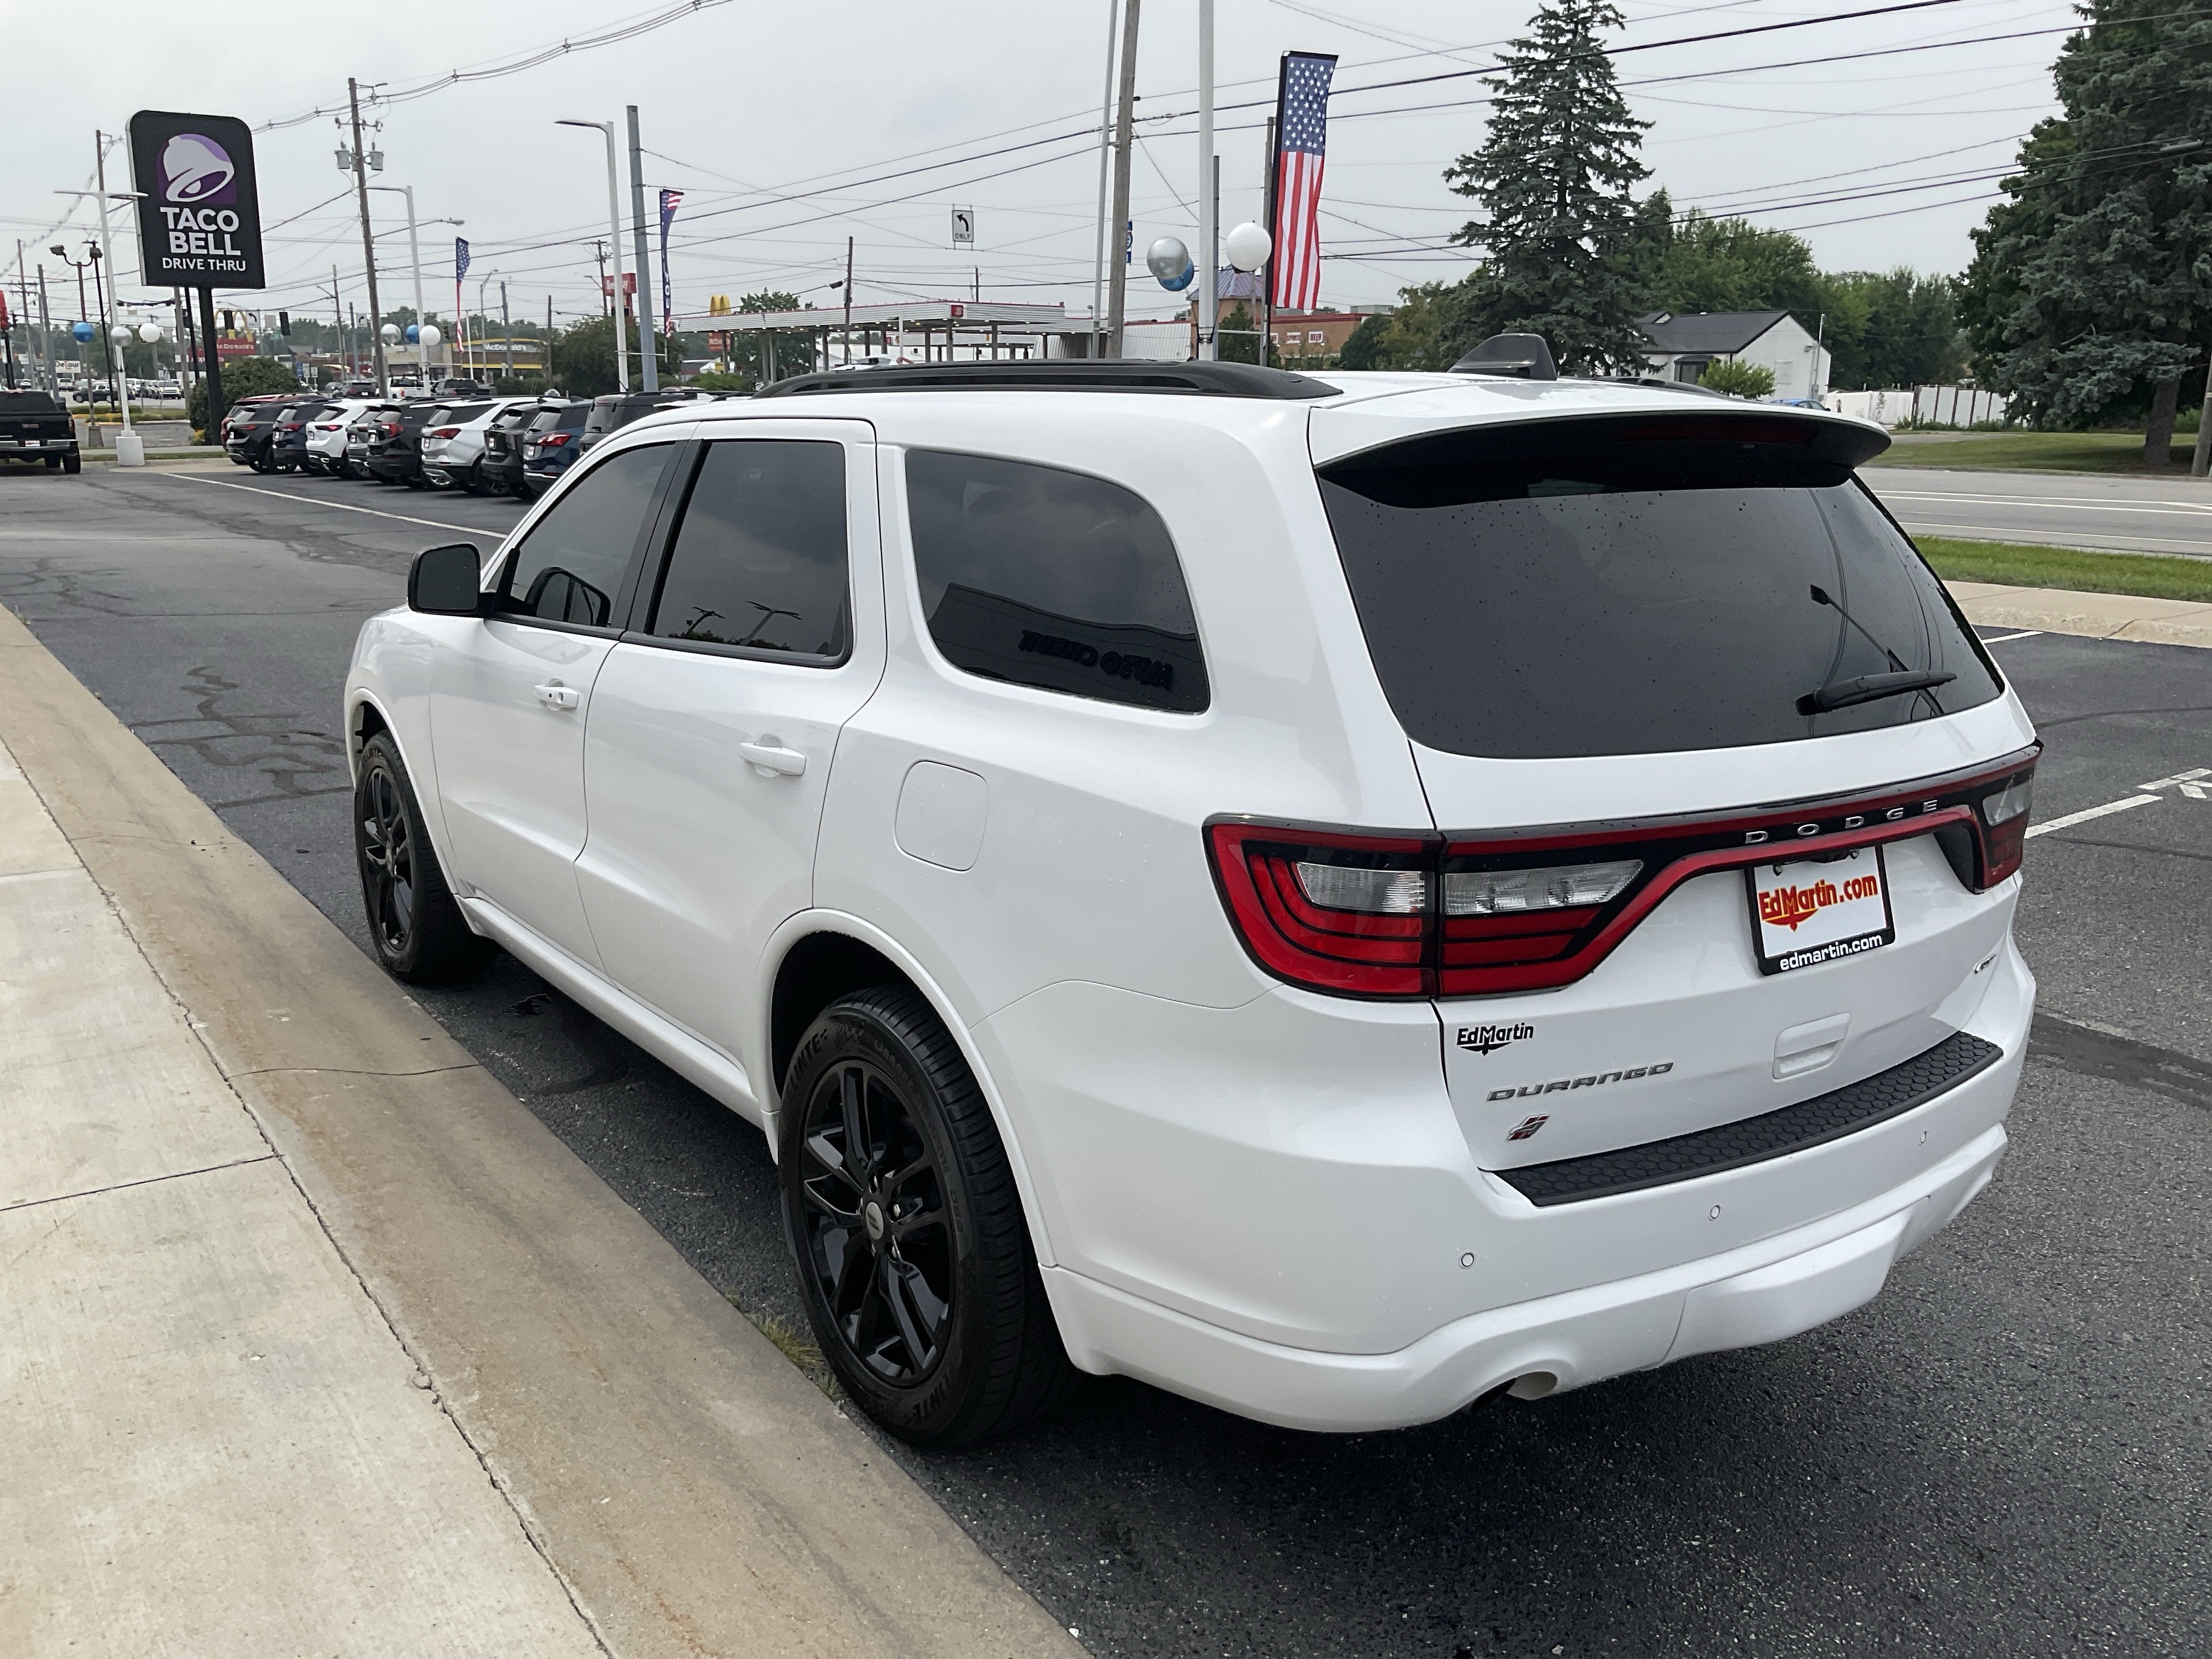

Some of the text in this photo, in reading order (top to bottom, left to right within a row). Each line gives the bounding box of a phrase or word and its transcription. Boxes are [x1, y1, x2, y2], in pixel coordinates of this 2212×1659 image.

[160, 207, 239, 232] TACO
[168, 231, 241, 256] BELL
[162, 257, 246, 272] DRIVE THRU
[1745, 799, 1938, 844] DODGE
[1758, 874, 1878, 922] EdMartin.com
[1780, 934, 1883, 970] edmartin.com
[1486, 1061, 1674, 1102] DURANGO
